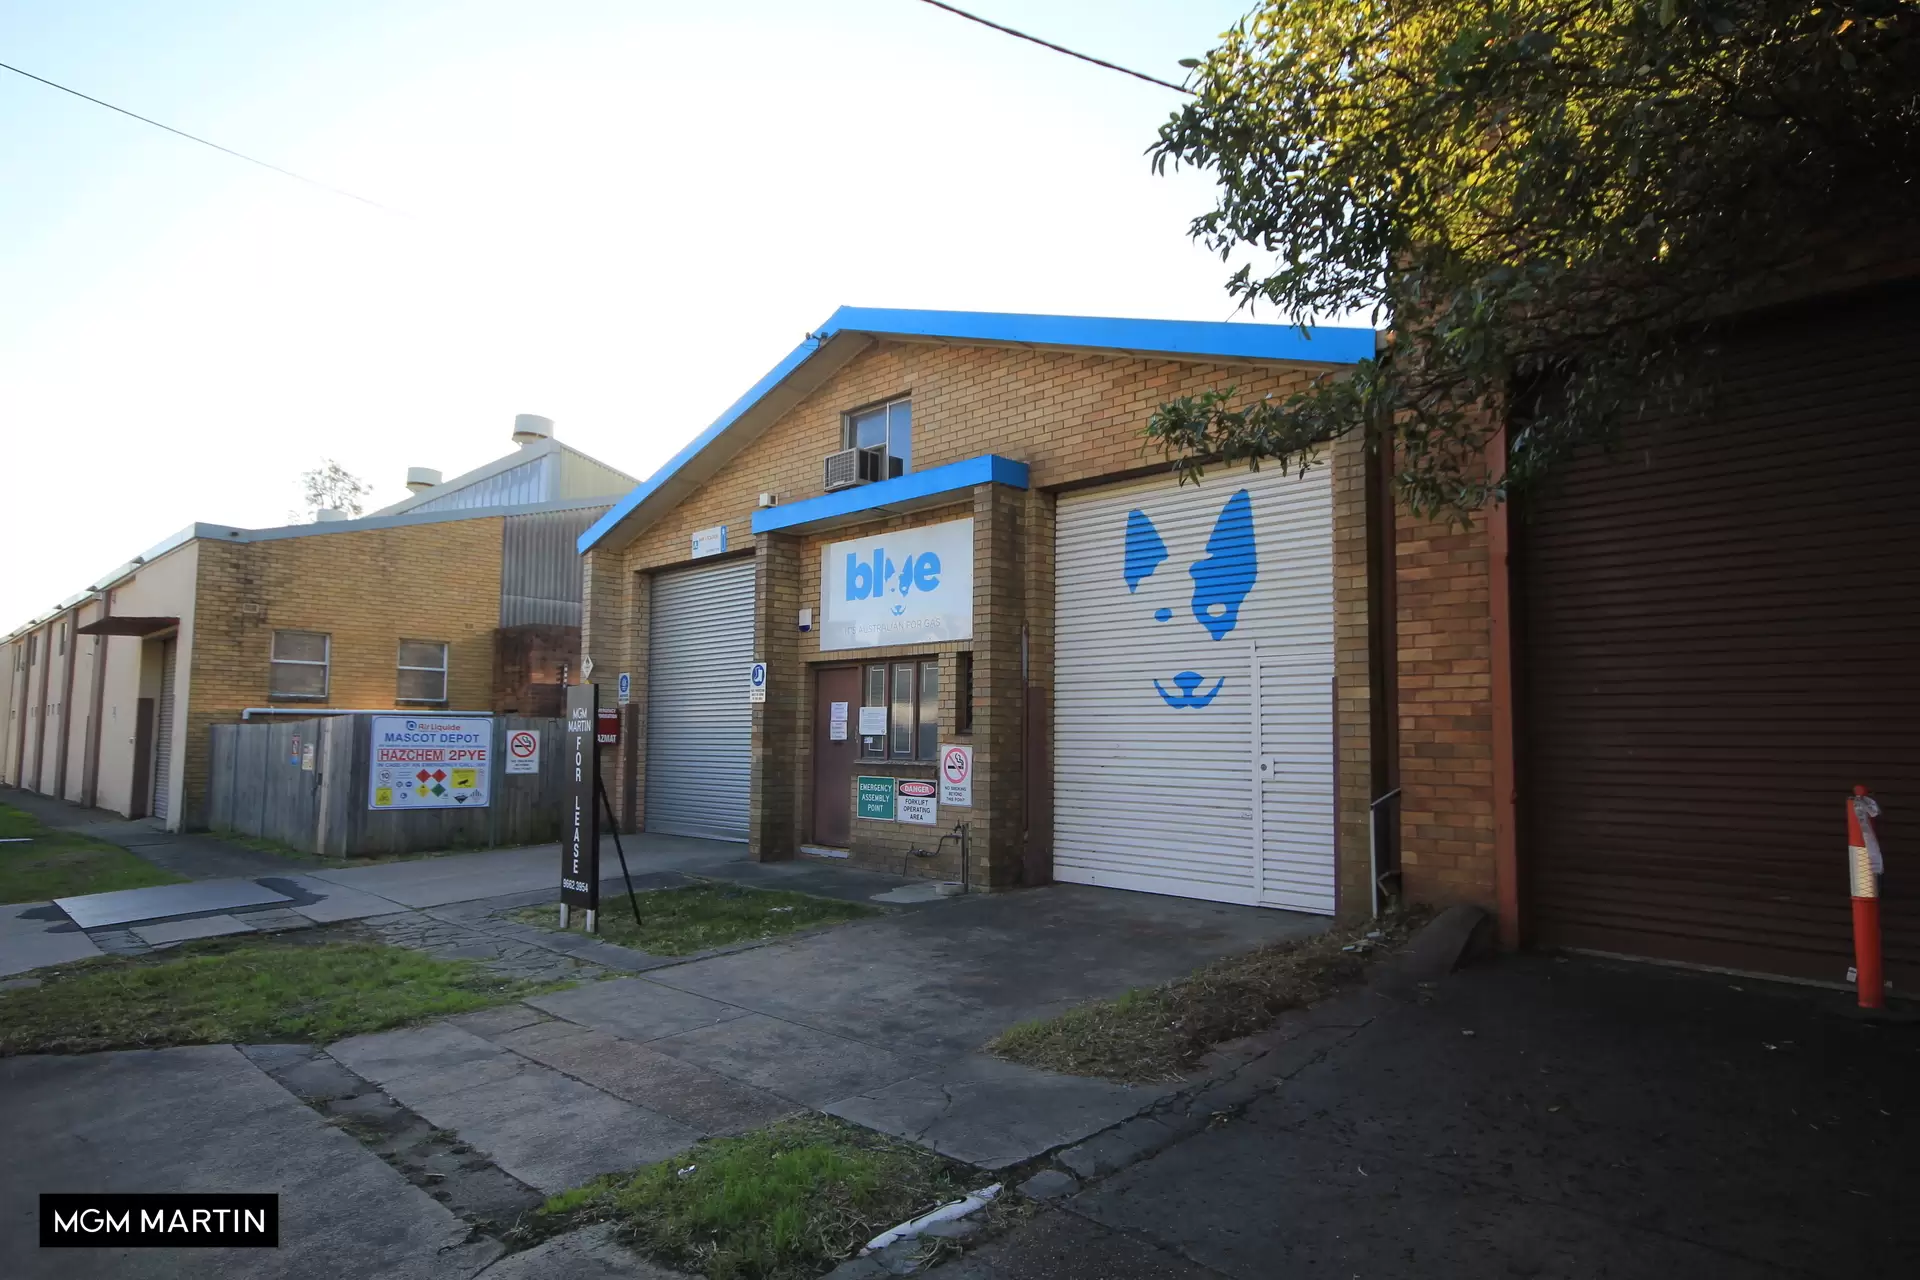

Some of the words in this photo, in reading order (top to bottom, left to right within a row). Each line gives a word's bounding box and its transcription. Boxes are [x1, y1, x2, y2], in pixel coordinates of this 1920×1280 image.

[858, 622, 905, 634] AUSTRALIAN
[906, 619, 922, 629] FOR
[924, 617, 941, 628] GAS
[572, 708, 588, 719] MGM
[431, 723, 461, 732] Liquide
[568, 719, 591, 732] MARTIN
[385, 732, 437, 743] MASCOT
[439, 733, 480, 744] DEPOT
[597, 734, 617, 743] AZMAT
[380, 749, 443, 761] HAZCHEM
[448, 749, 487, 761] 2PYE
[860, 783, 893, 793] EMERGENCY
[904, 786, 930, 794] DANGER
[861, 793, 890, 803] ASSEMBLY
[905, 798, 929, 806] FORKLIFT
[867, 803, 884, 812] POINT
[903, 806, 931, 814] OPERATING
[909, 813, 924, 821] AREA
[573, 796, 581, 874] LEASE
